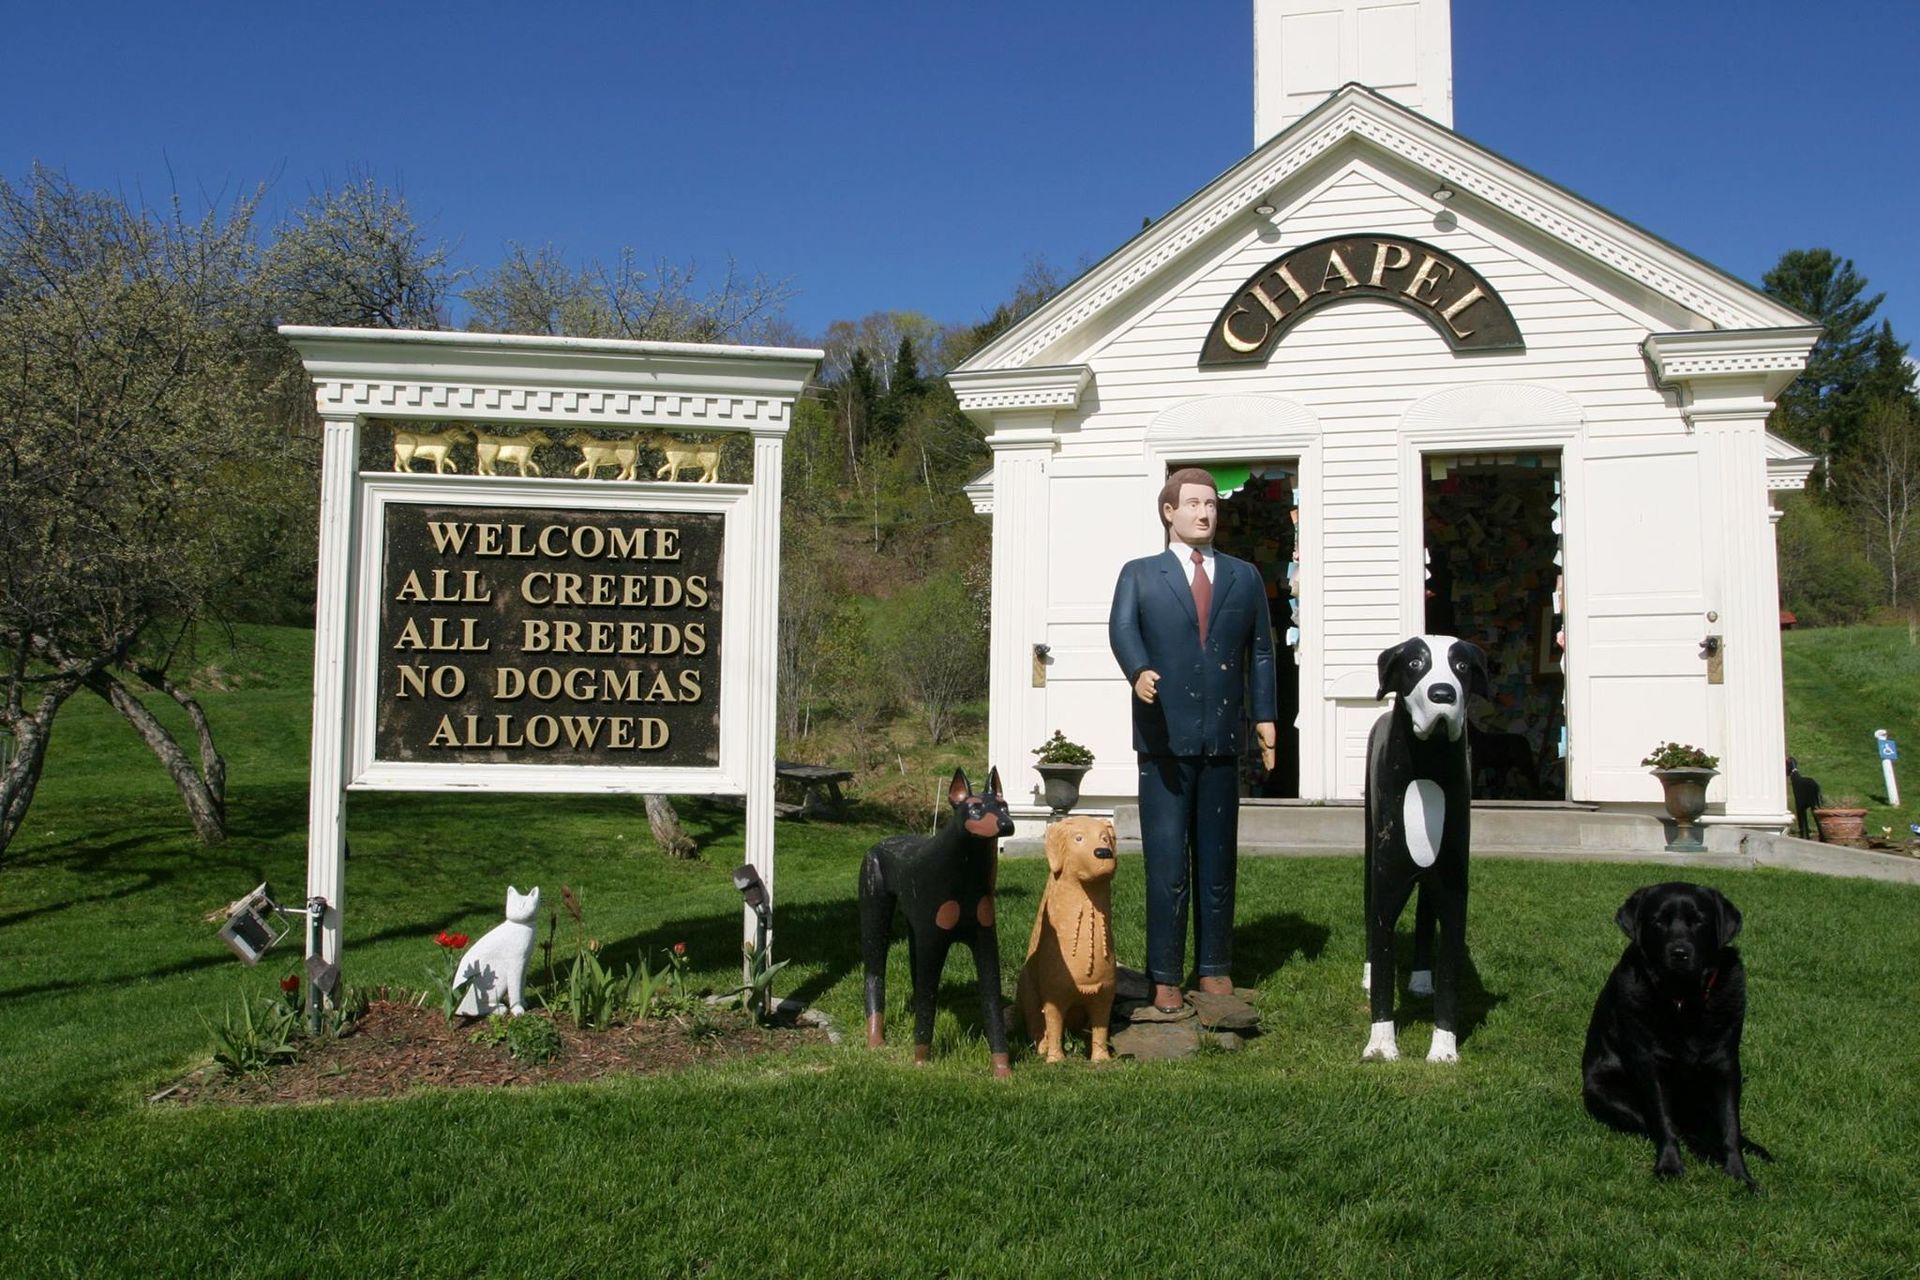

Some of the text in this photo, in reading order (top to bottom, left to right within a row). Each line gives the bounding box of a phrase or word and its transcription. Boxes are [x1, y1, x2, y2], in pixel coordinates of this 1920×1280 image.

[1223, 243, 1488, 352] CHAPEL
[428, 521, 680, 560] WELCOME
[396, 569, 709, 608] ALL CREEDS
[394, 617, 706, 655] ALL BREEDS
[396, 665, 702, 702] NO DOGMAS
[429, 714, 670, 750] ALLOWED
